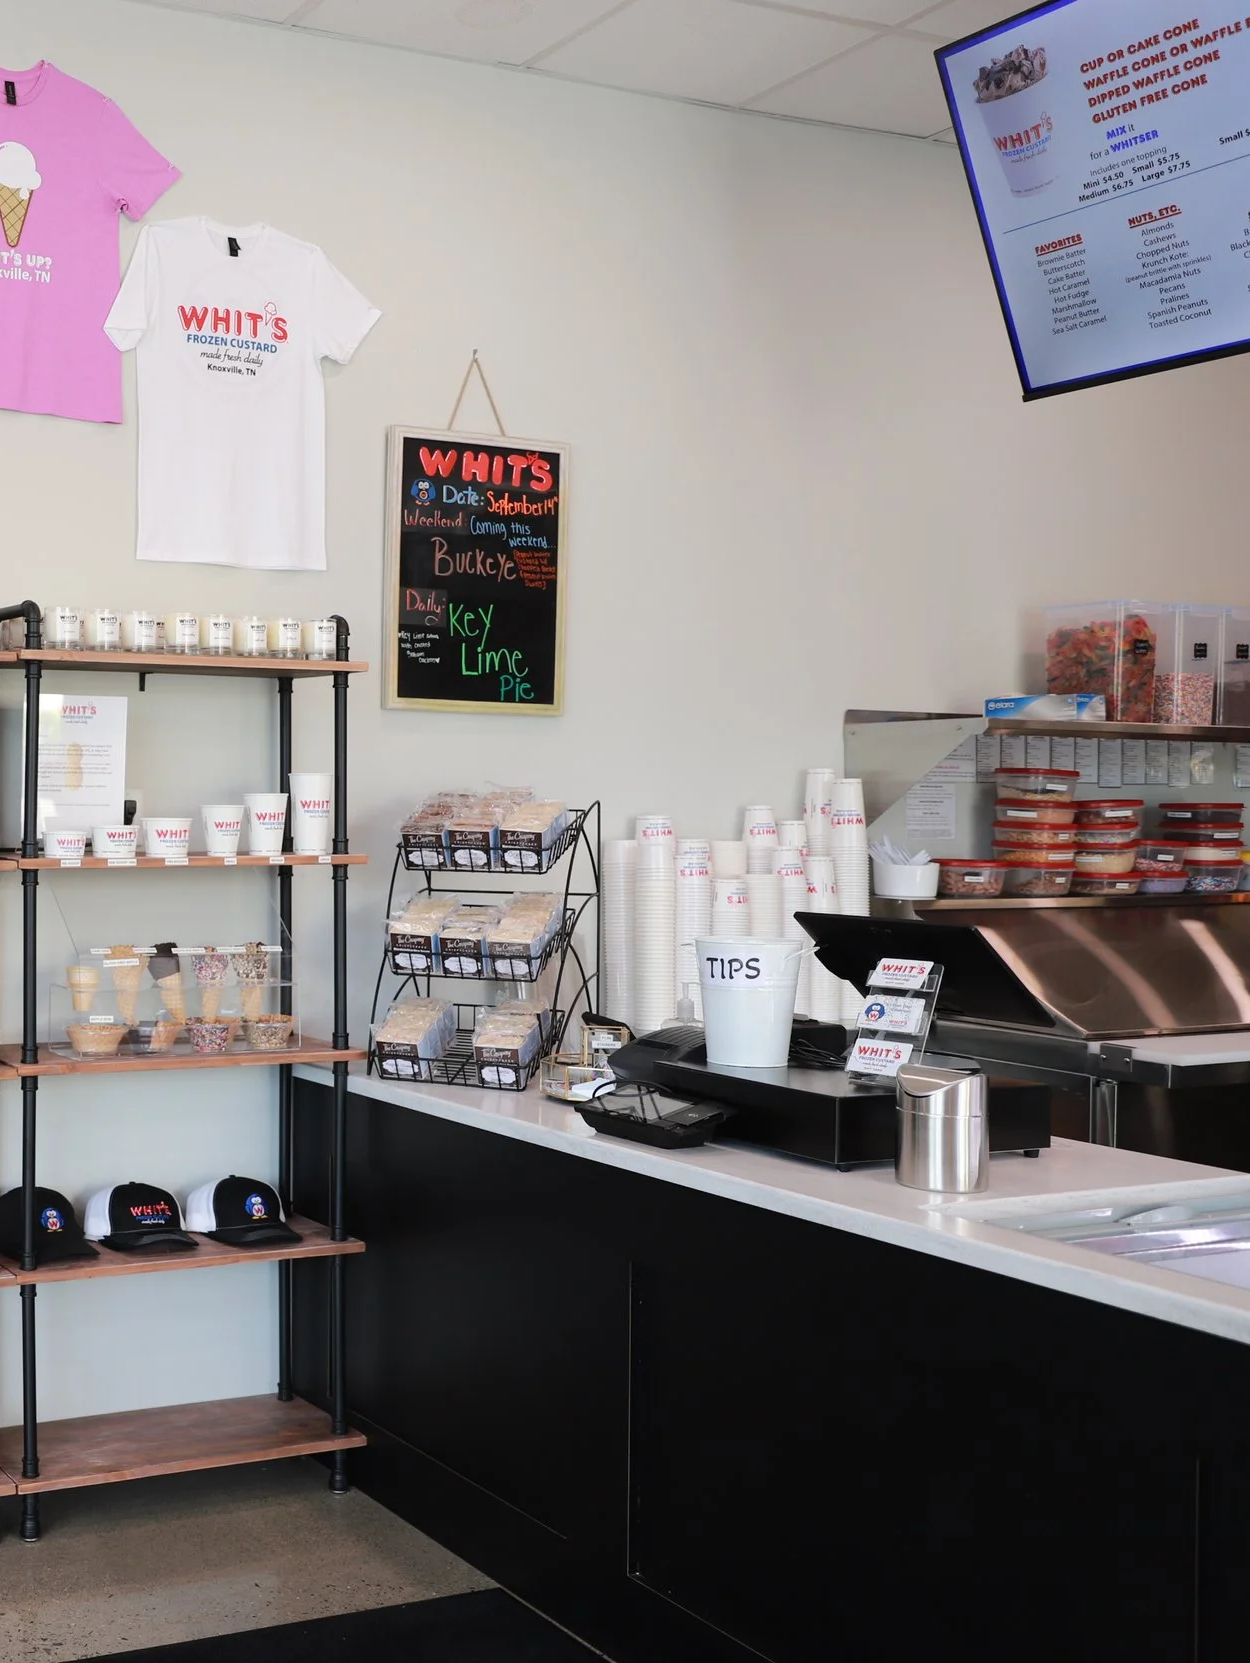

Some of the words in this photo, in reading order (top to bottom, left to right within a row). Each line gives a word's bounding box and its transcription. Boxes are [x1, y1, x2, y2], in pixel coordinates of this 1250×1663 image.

[1080, 57, 1104, 74] CUP
[1107, 49, 1125, 63] OR
[1127, 34, 1161, 56] CAKE
[1162, 18, 1200, 41] CONE
[1083, 65, 1129, 90] WAFFLE
[1131, 51, 1167, 72] CONE
[1169, 43, 1189, 58] OR
[1190, 21, 1243, 49] WAFFLE
[1087, 84, 1131, 108] DIPPED
[1132, 65, 1181, 90] WAFFLE
[1183, 49, 1221, 71] CONE
[1092, 100, 1138, 124] GLUTEN
[1140, 88, 1169, 107] FREE
[1171, 74, 1208, 95] CONE
[1106, 125, 1127, 140] MIX
[1128, 123, 1135, 132] it
[1219, 130, 1244, 146] Small
[1090, 151, 1103, 161] for
[1110, 129, 1159, 153] WHITSER
[1083, 180, 1101, 191] Mini
[1103, 171, 1124, 184] $4.50
[1132, 161, 1155, 175] Small
[1157, 152, 1180, 166] $5.75
[1090, 163, 1120, 177] Includes
[1121, 156, 1136, 167] one
[1137, 146, 1167, 162] topping
[1078, 188, 1110, 203] Medium
[1112, 179, 1134, 192] $6.75
[1141, 170, 1165, 183] Large
[1168, 160, 1191, 174] $7.75
[1128, 212, 1157, 226] NUTS,
[1158, 205, 1181, 217] ETC.
[1141, 221, 1174, 237] Almonds
[1143, 232, 1177, 247] Cashews
[1035, 234, 1082, 254] FAVORITES
[1136, 244, 1170, 260] Chopped
[1172, 239, 1190, 250] Nuts
[26, 254, 52, 270] UP?
[1037, 256, 1065, 268] Brownie
[1066, 248, 1086, 259] Batter
[1043, 259, 1086, 276] Butterscotch
[1141, 256, 1168, 269] Krunch
[1170, 251, 1189, 261] Kote:
[34, 270, 51, 283] TN
[1048, 276, 1064, 285] Cake
[1065, 270, 1086, 280] Batter
[1125, 272, 1148, 284] (peanut
[1148, 267, 1167, 277] brittle
[1168, 263, 1182, 272] with
[1182, 254, 1212, 268] sprinkles)
[1139, 273, 1182, 289] Macadamia
[1183, 267, 1201, 278] Nuts
[1048, 287, 1061, 295] Hot
[1062, 278, 1090, 291] Caramel
[1054, 296, 1067, 304] Hot
[1068, 290, 1090, 301] Fudge
[1159, 282, 1186, 295] Pecans
[1052, 298, 1097, 315] Marshmallow
[1147, 307, 1177, 320] Spanish
[1178, 298, 1209, 312] Peanuts
[1160, 292, 1190, 305] Pralines
[177, 301, 289, 344] WHIT'S
[1054, 313, 1077, 324] Peanut
[1078, 308, 1100, 319] Butter
[1065, 323, 1078, 332] Salt
[1079, 315, 1108, 329] Caramel
[1149, 316, 1178, 329] Toasted
[1179, 308, 1212, 322] Coconut
[186, 333, 228, 347] FROZEN
[230, 338, 278, 354] CUSTARD
[200, 347, 221, 360] made
[220, 348, 242, 363] fresh
[243, 351, 263, 368] daily
[207, 363, 244, 376] Knoxville,
[246, 367, 257, 376] TN
[442, 484, 485, 506] Date:
[404, 509, 468, 529] Weekend:
[469, 515, 507, 540] Coming
[511, 521, 531, 536] this
[449, 603, 494, 648] Key
[462, 643, 528, 677] Lime
[500, 675, 534, 702] Pie
[706, 957, 762, 981] TIPS
[882, 963, 926, 975] WHIT'S
[858, 1045, 902, 1059] WHIT'S
